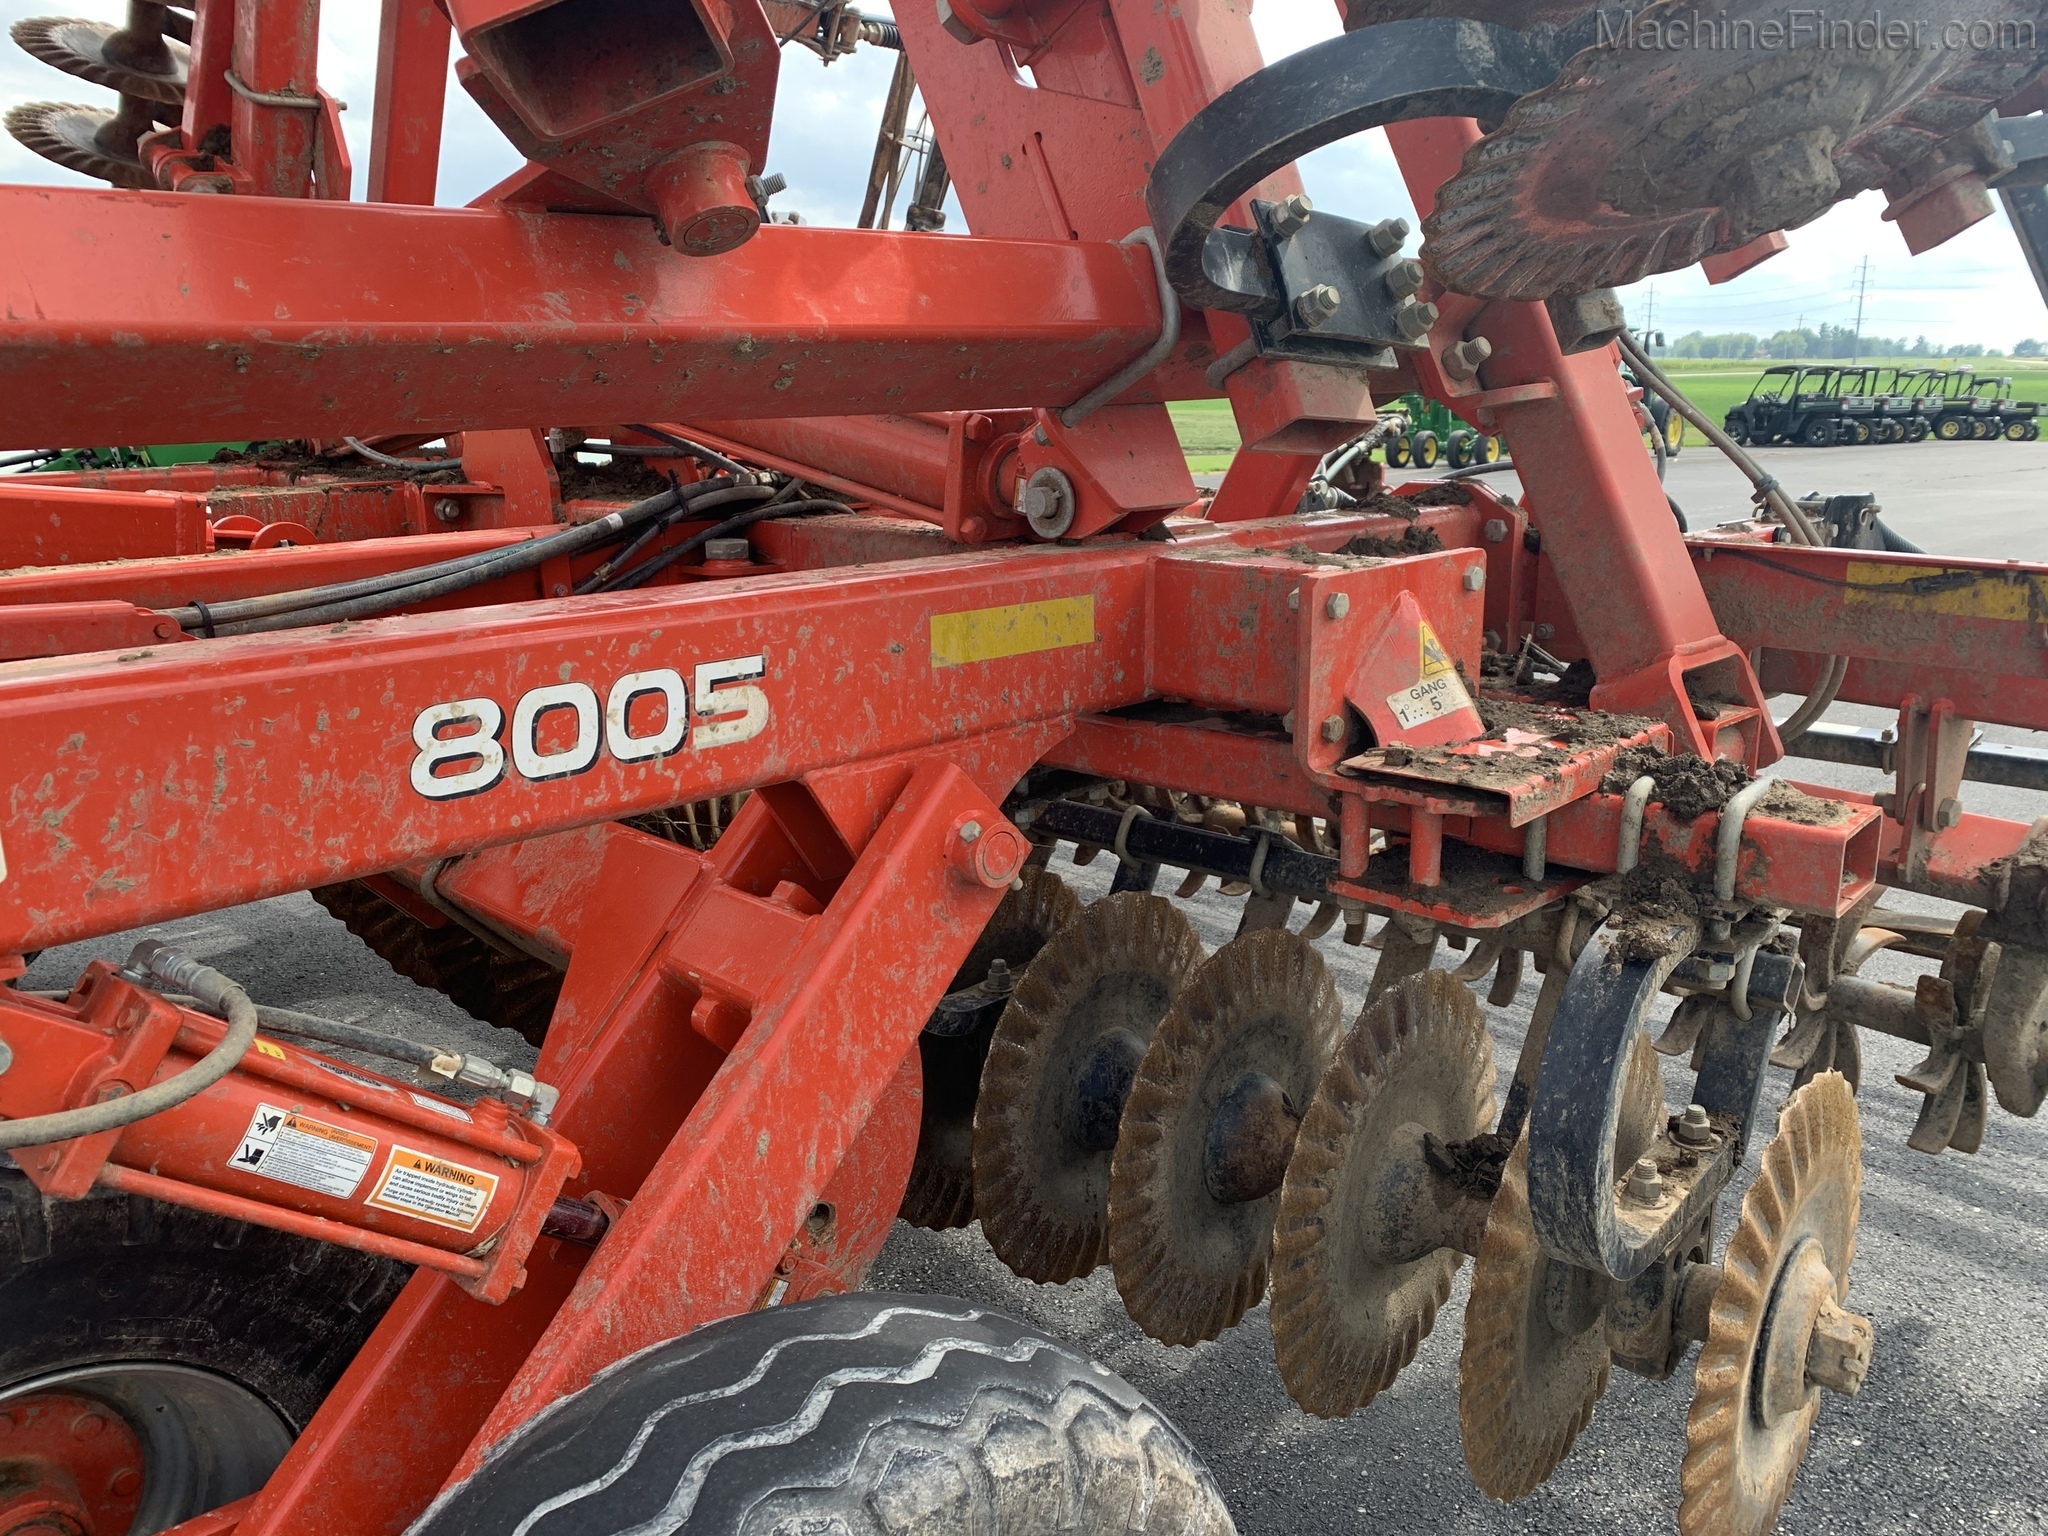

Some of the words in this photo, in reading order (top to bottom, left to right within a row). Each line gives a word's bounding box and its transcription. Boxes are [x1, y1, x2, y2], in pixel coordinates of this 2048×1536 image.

[1410, 678, 1447, 700] GANG
[410, 654, 769, 802] 8005
[299, 1122, 329, 1135] WARNING
[403, 1171, 421, 1180] trapped
[436, 1180, 456, 1190] hydraulic
[457, 1187, 477, 1196] cylinders
[424, 1161, 475, 1185] WARNING
[415, 1181, 439, 1191] implement
